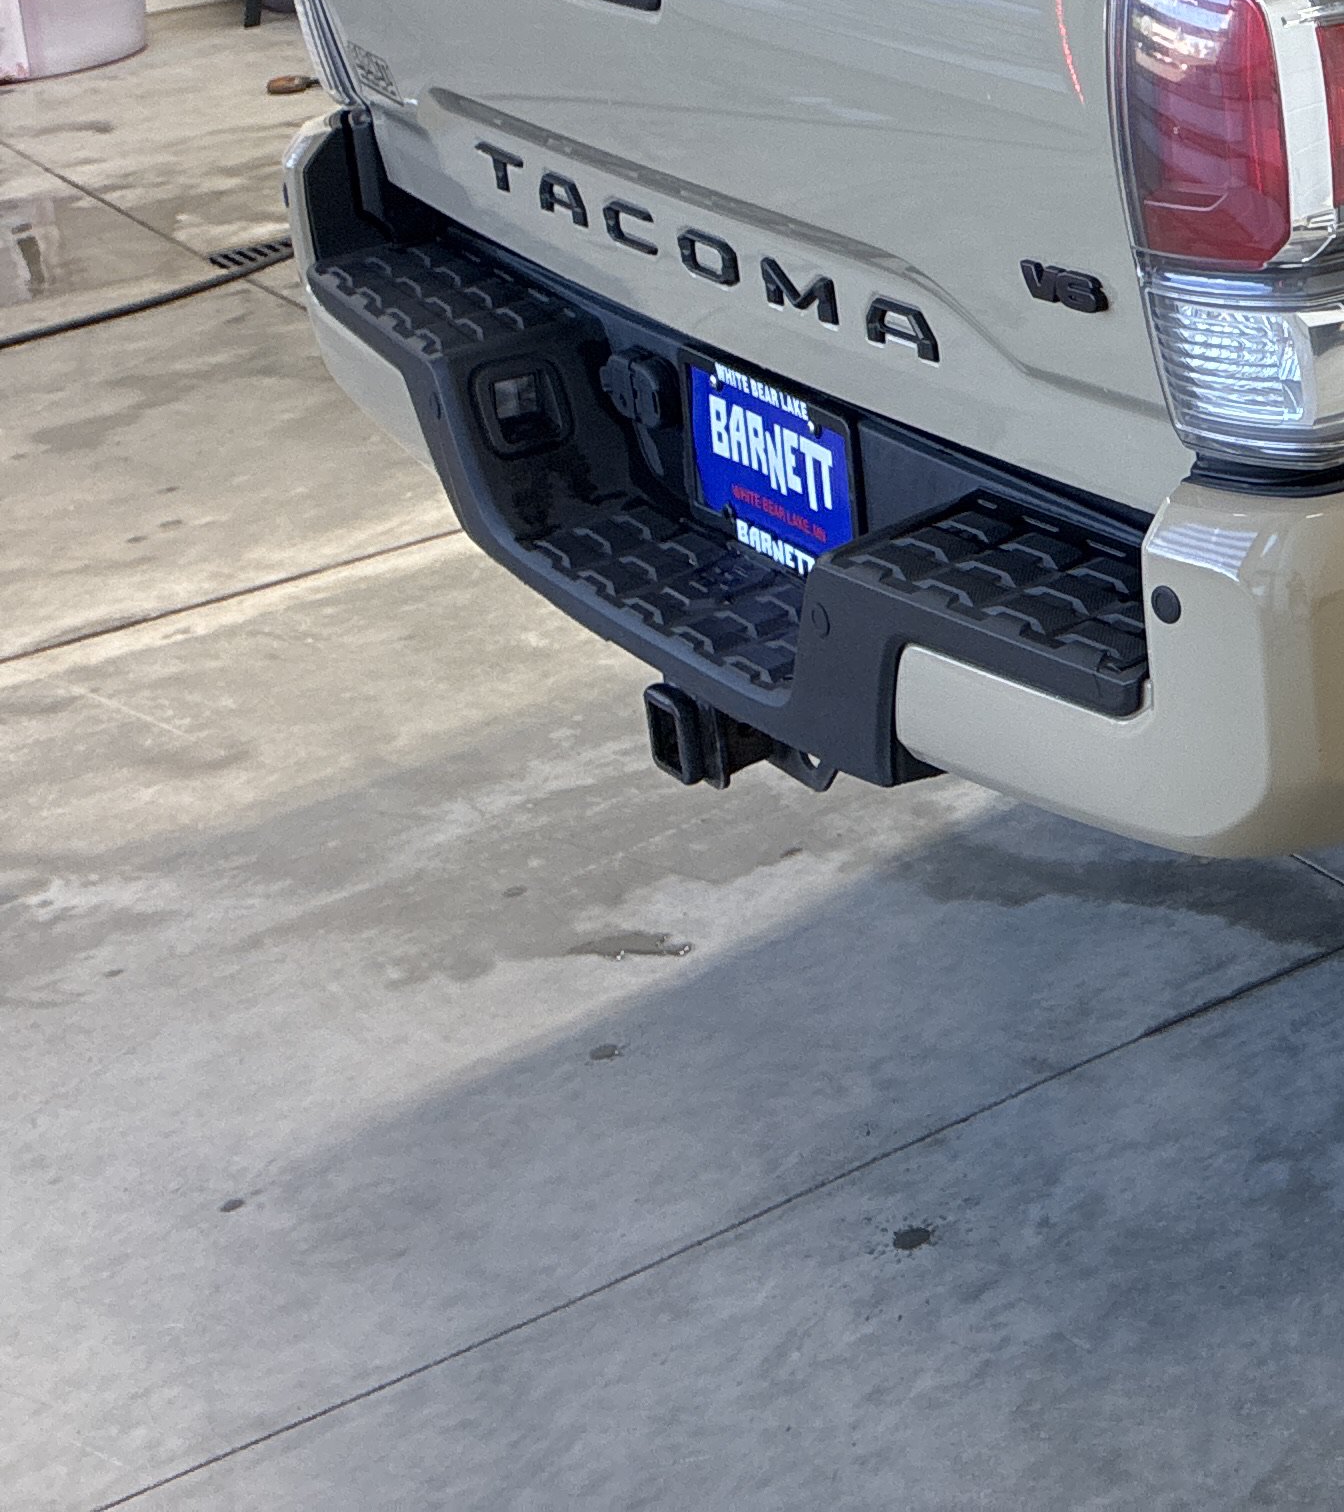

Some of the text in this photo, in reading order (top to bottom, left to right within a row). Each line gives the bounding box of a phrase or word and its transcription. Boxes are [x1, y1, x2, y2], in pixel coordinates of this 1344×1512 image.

[475, 140, 940, 365] TACOMA
[1020, 259, 1110, 313] V6
[715, 362, 809, 421] WHITE BEAR LAKE
[709, 394, 833, 512] BARNETT
[731, 482, 762, 509] WHITE
[762, 496, 787, 522] BEAR
[736, 518, 815, 575] BARNETT
